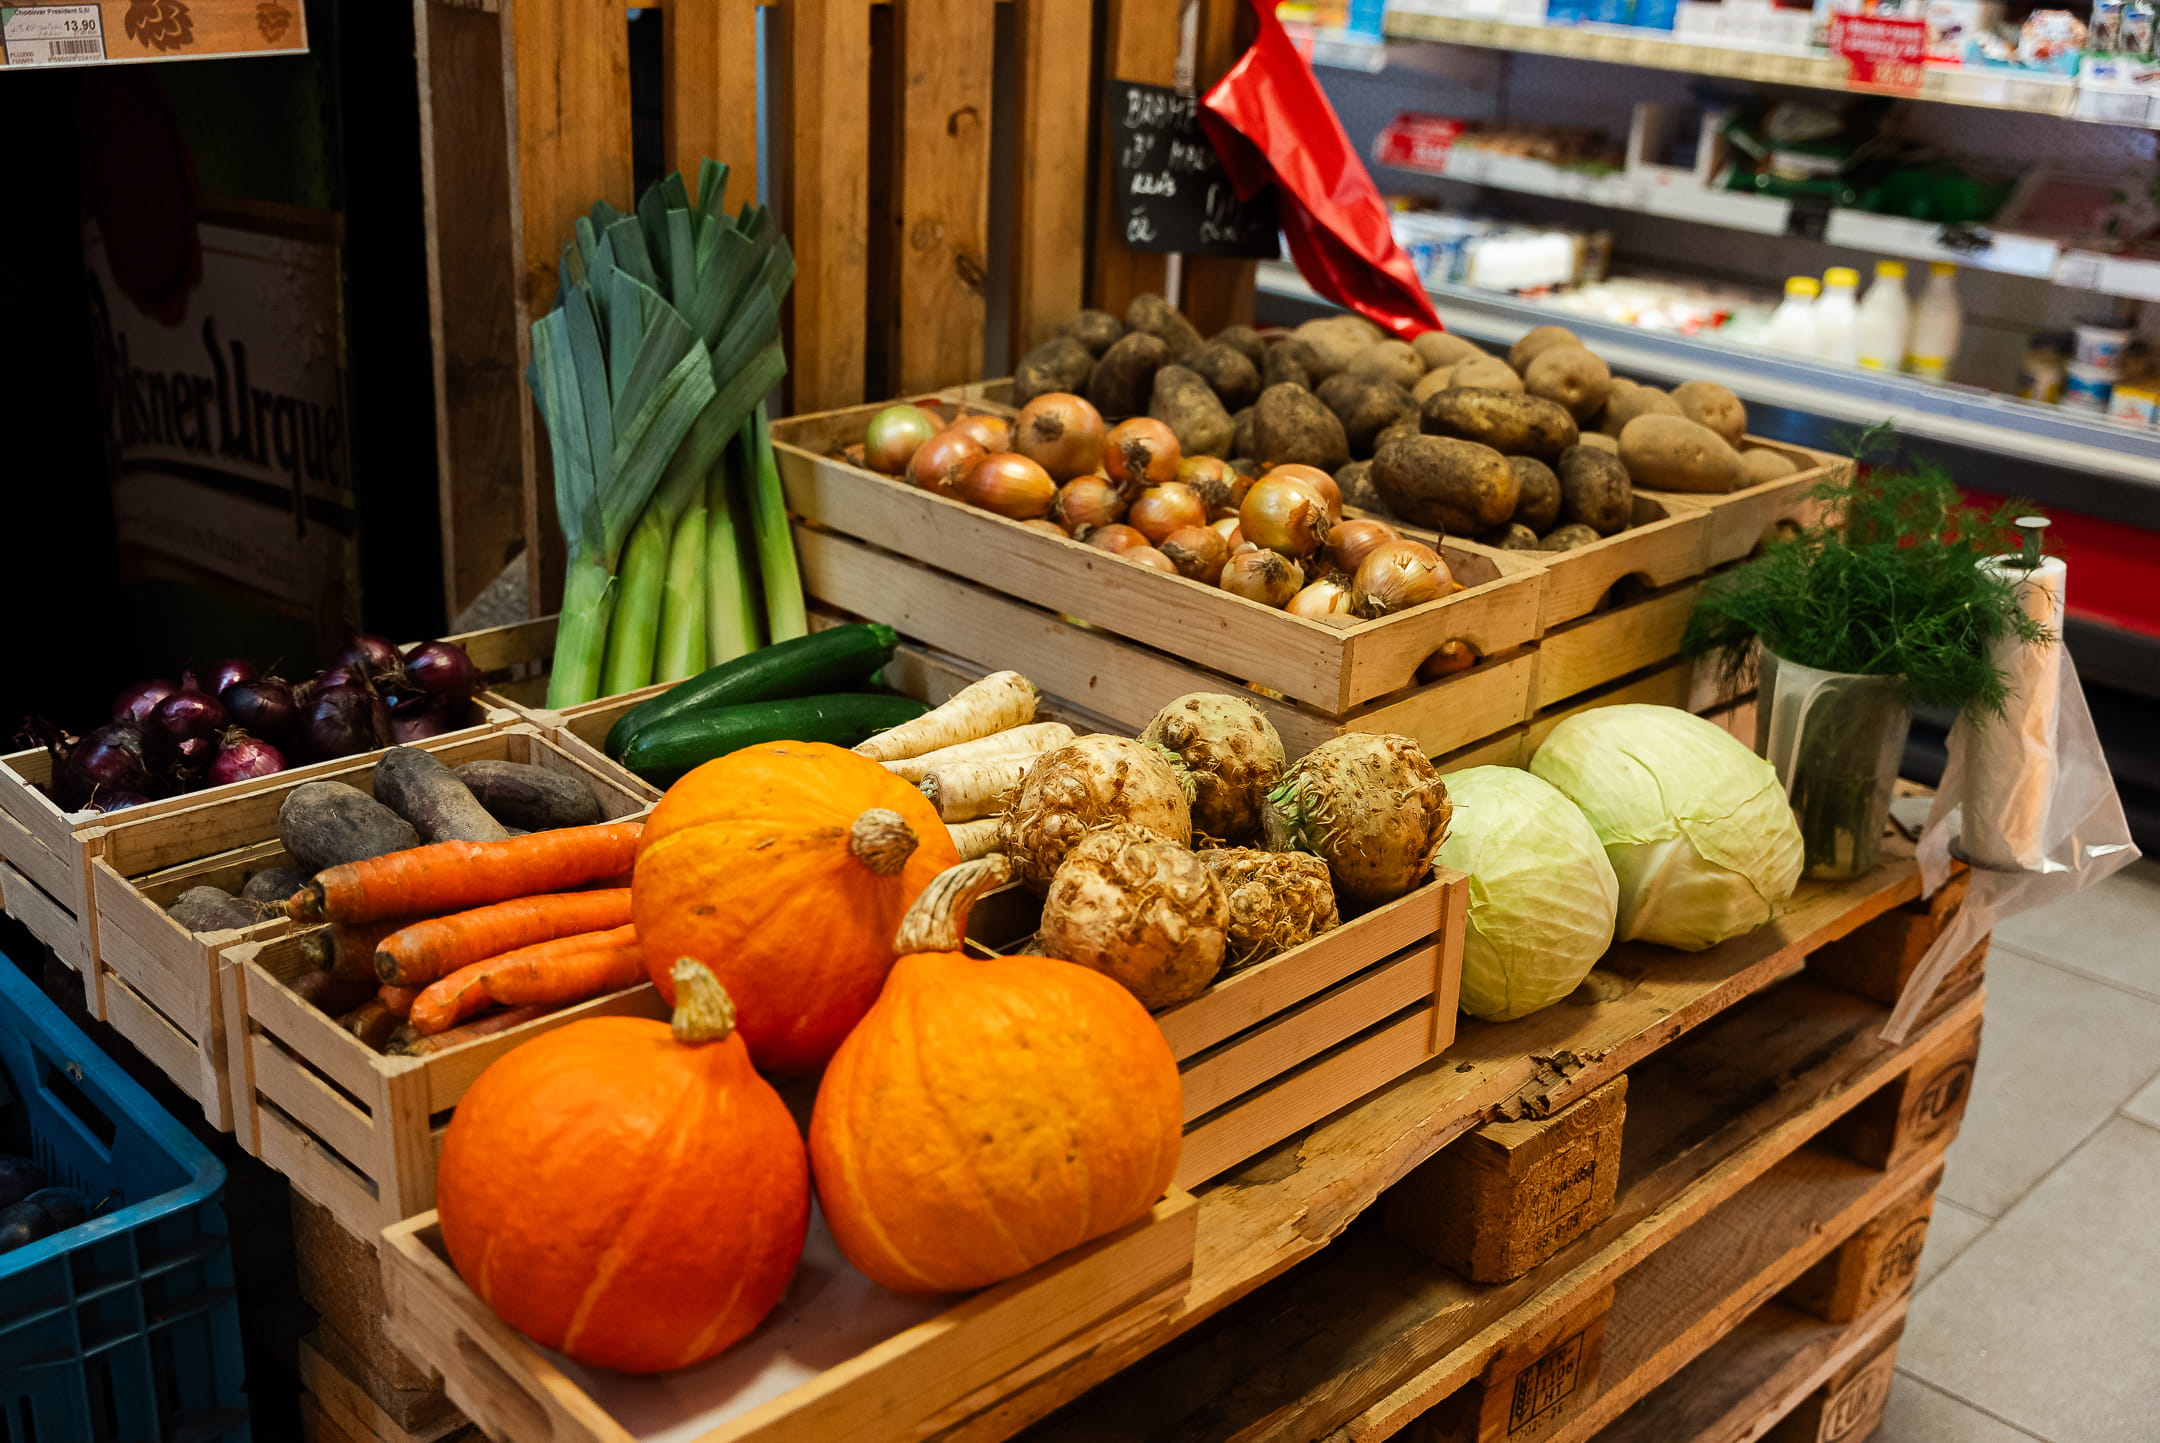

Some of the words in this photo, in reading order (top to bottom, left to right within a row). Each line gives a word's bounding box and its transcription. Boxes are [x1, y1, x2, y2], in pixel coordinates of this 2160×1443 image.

[47, 7, 77, 15] President
[64, 19, 96, 31] 13.90
[1541, 1357, 1575, 1393] 1106
[1543, 1380, 1564, 1406] HT
